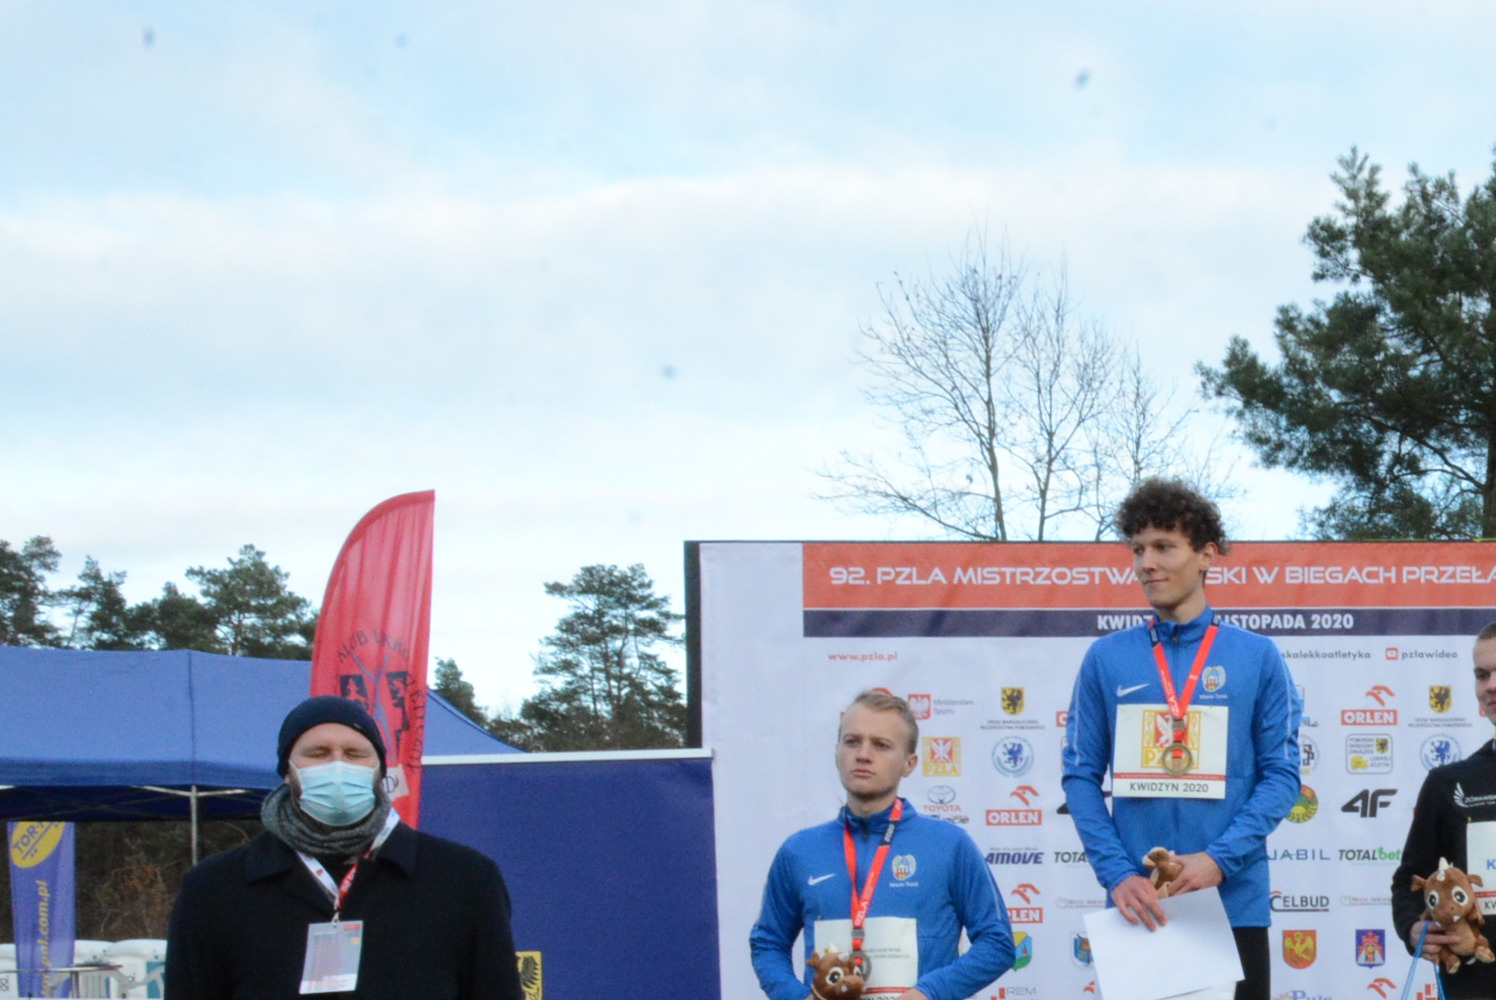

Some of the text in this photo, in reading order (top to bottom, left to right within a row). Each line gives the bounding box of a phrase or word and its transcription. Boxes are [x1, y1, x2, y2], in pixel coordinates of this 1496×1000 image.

[830, 567, 870, 584] 92.
[877, 567, 947, 584] PZLA
[1206, 566, 1247, 584] SKI
[1252, 566, 1279, 584] W
[1285, 566, 1396, 584] BIEGACH
[1097, 614, 1153, 630] KWID
[1311, 613, 1354, 629] 2020
[828, 651, 898, 662] www.pzla.pl
[1280, 649, 1371, 661] skalekkoatletyka
[1401, 649, 1458, 661] pzlawideo
[1344, 711, 1395, 724] ORLEN
[924, 762, 960, 775] PZLA
[1129, 782, 1209, 793] KWIDZYN 2020
[923, 804, 961, 812] TOYOTA
[1341, 788, 1398, 818] 4F
[988, 811, 1038, 824] ORLEN
[1054, 851, 1088, 864] TOTA
[1338, 846, 1402, 861] TOTALbet
[1008, 910, 1040, 922] LEN
